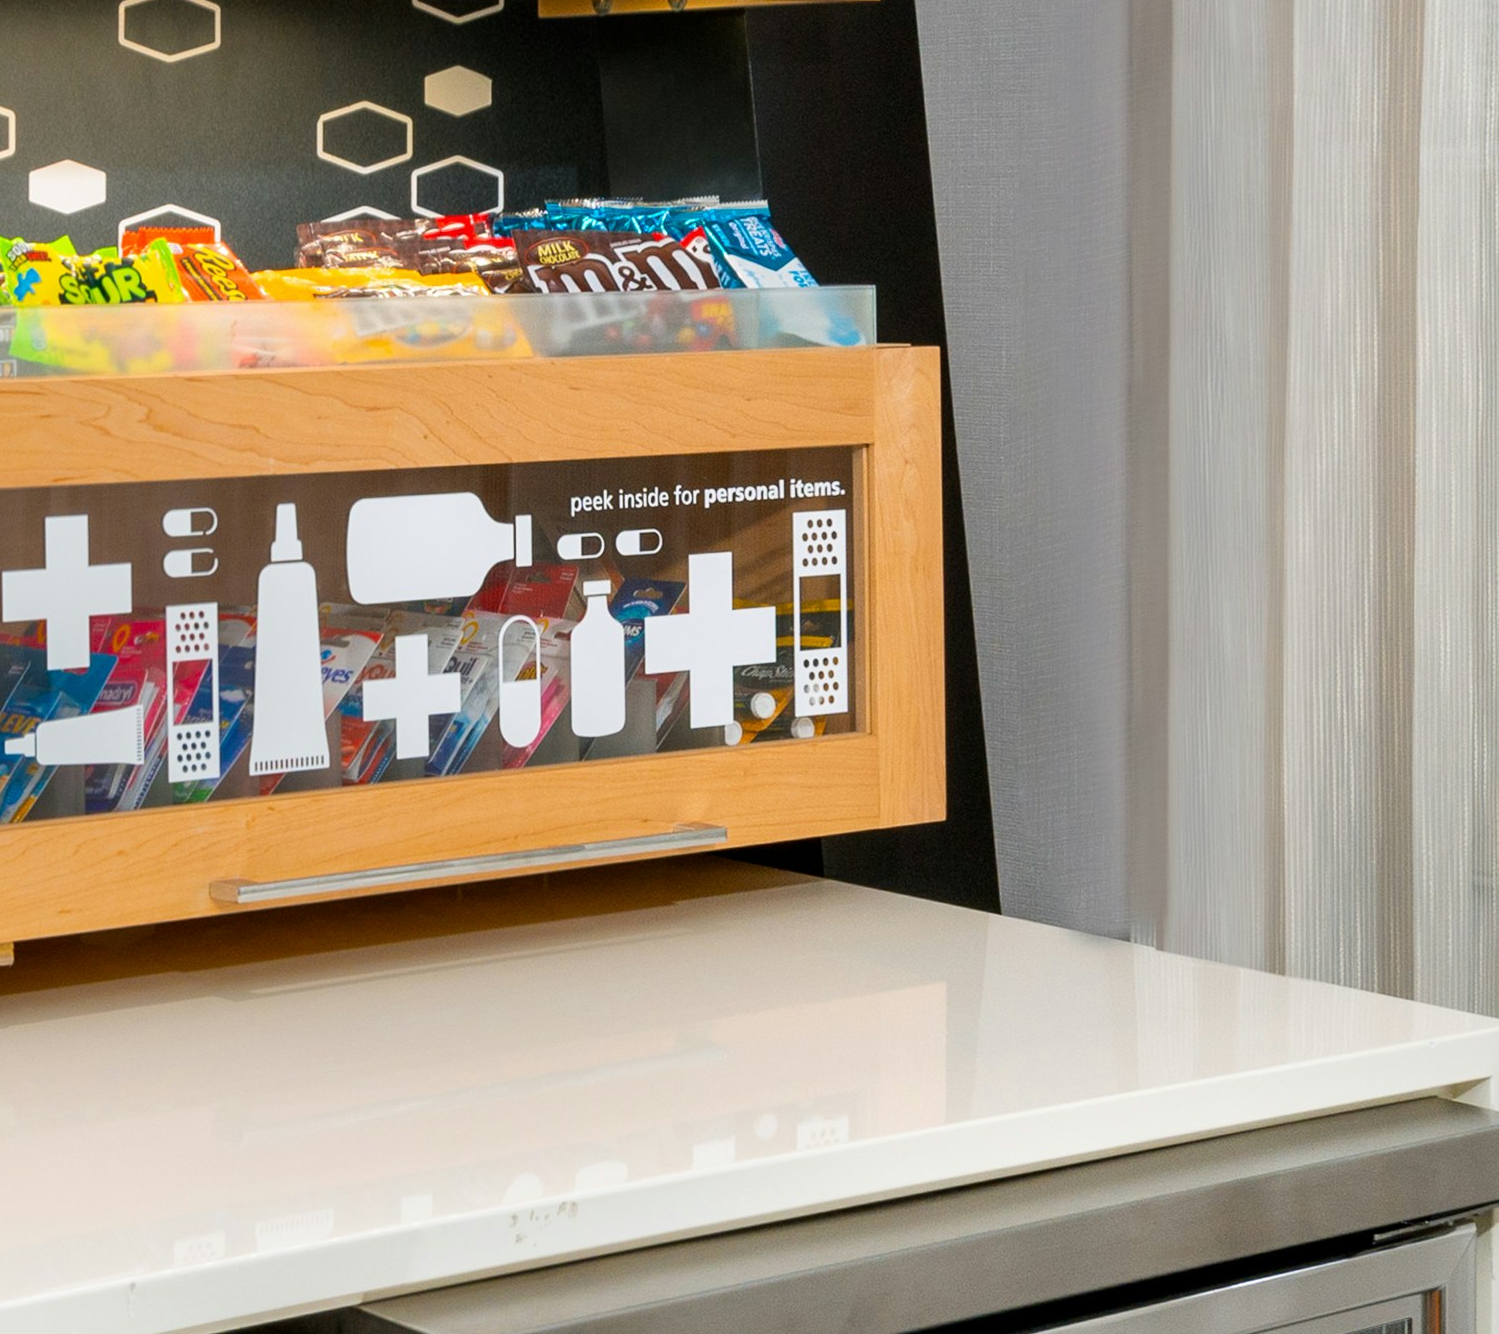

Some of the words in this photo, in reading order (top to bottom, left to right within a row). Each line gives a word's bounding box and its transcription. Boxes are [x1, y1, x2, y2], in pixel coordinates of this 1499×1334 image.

[536, 240, 573, 257] MILK
[538, 250, 582, 266] CHOCOLATE
[59, 264, 149, 306] SOUR
[570, 489, 614, 517] peek
[618, 486, 670, 510] inside
[673, 484, 700, 506] for
[703, 478, 786, 509] personal
[789, 478, 847, 498] items.
